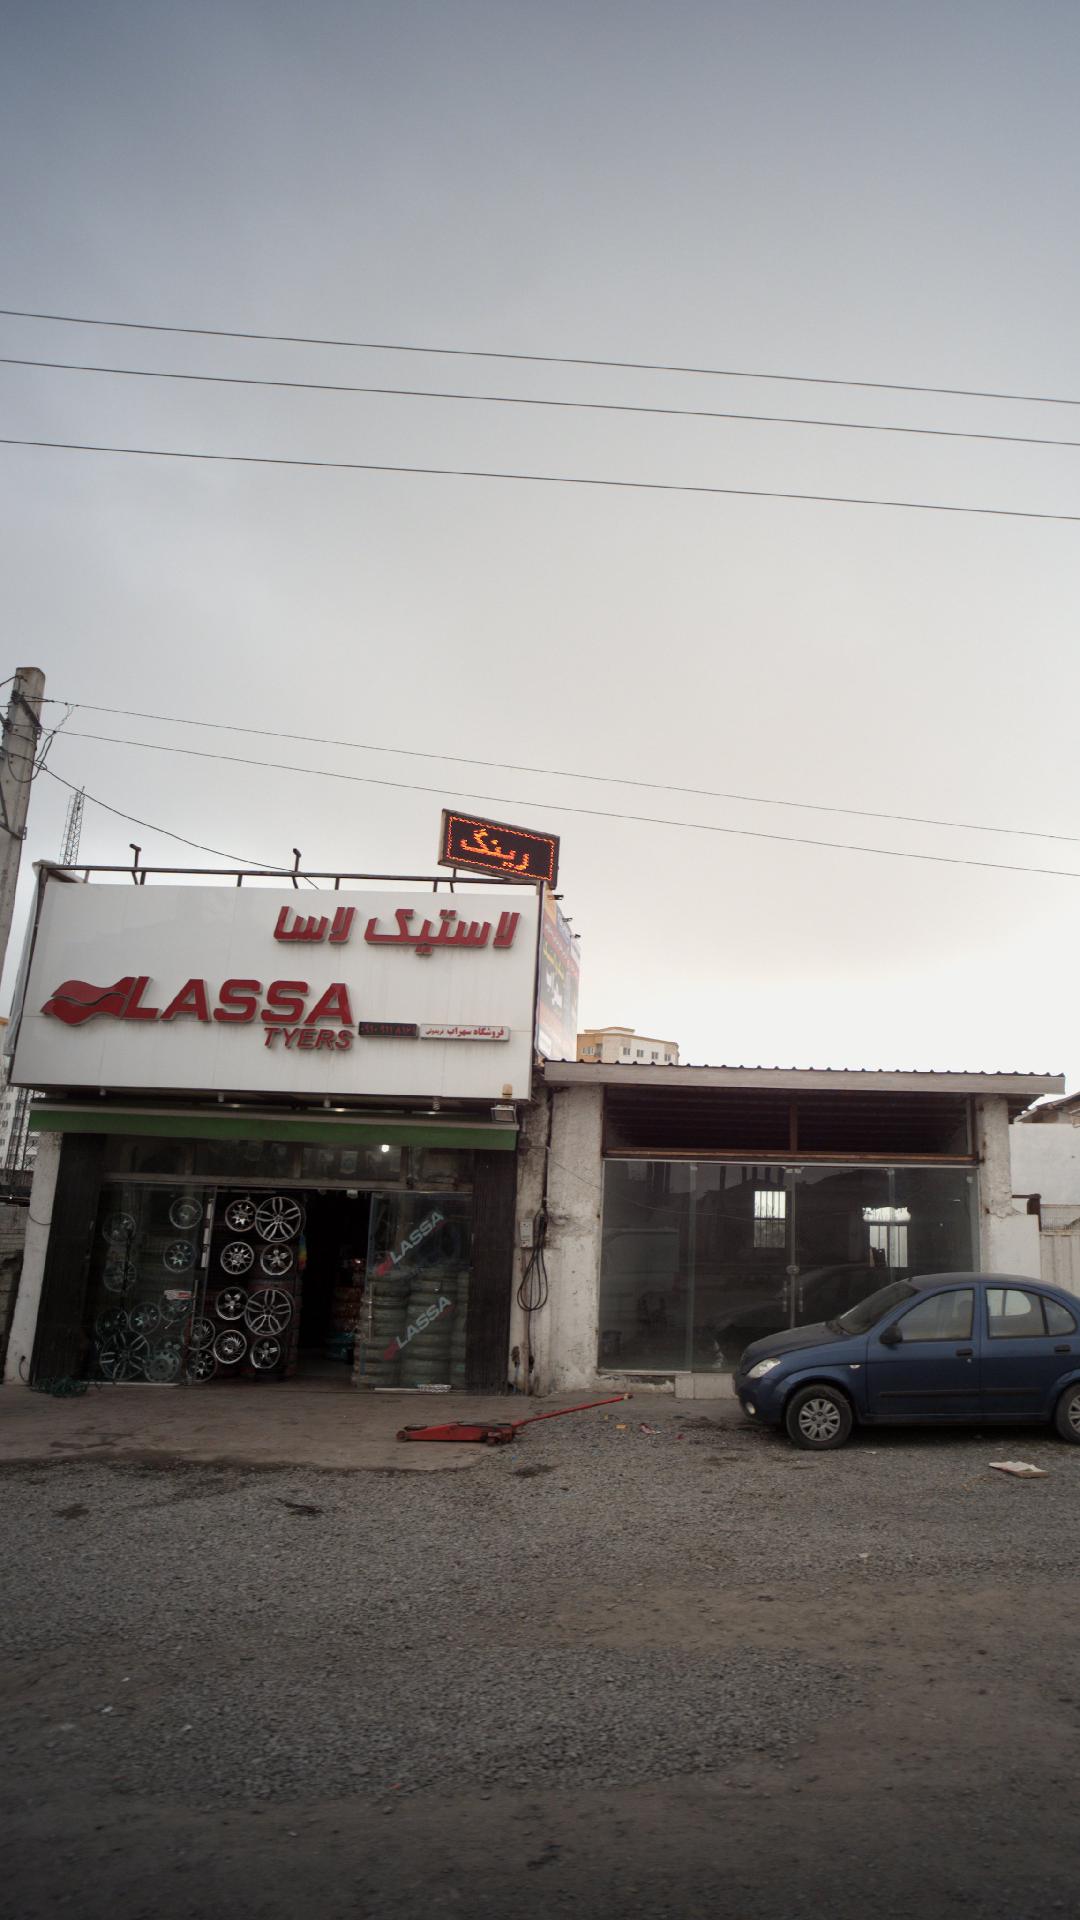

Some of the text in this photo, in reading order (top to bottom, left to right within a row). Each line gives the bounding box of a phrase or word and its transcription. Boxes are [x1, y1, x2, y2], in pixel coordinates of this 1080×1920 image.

[460, 828, 529, 871] رینگ
[273, 905, 356, 943] لاسا
[364, 908, 521, 956] لاستیک
[119, 976, 354, 1027] LASSA
[264, 1027, 354, 1050] TYERS
[473, 1026, 505, 1039] فروشگاه
[390, 1211, 445, 1265] LASSA
[396, 1296, 452, 1349] LASSA
